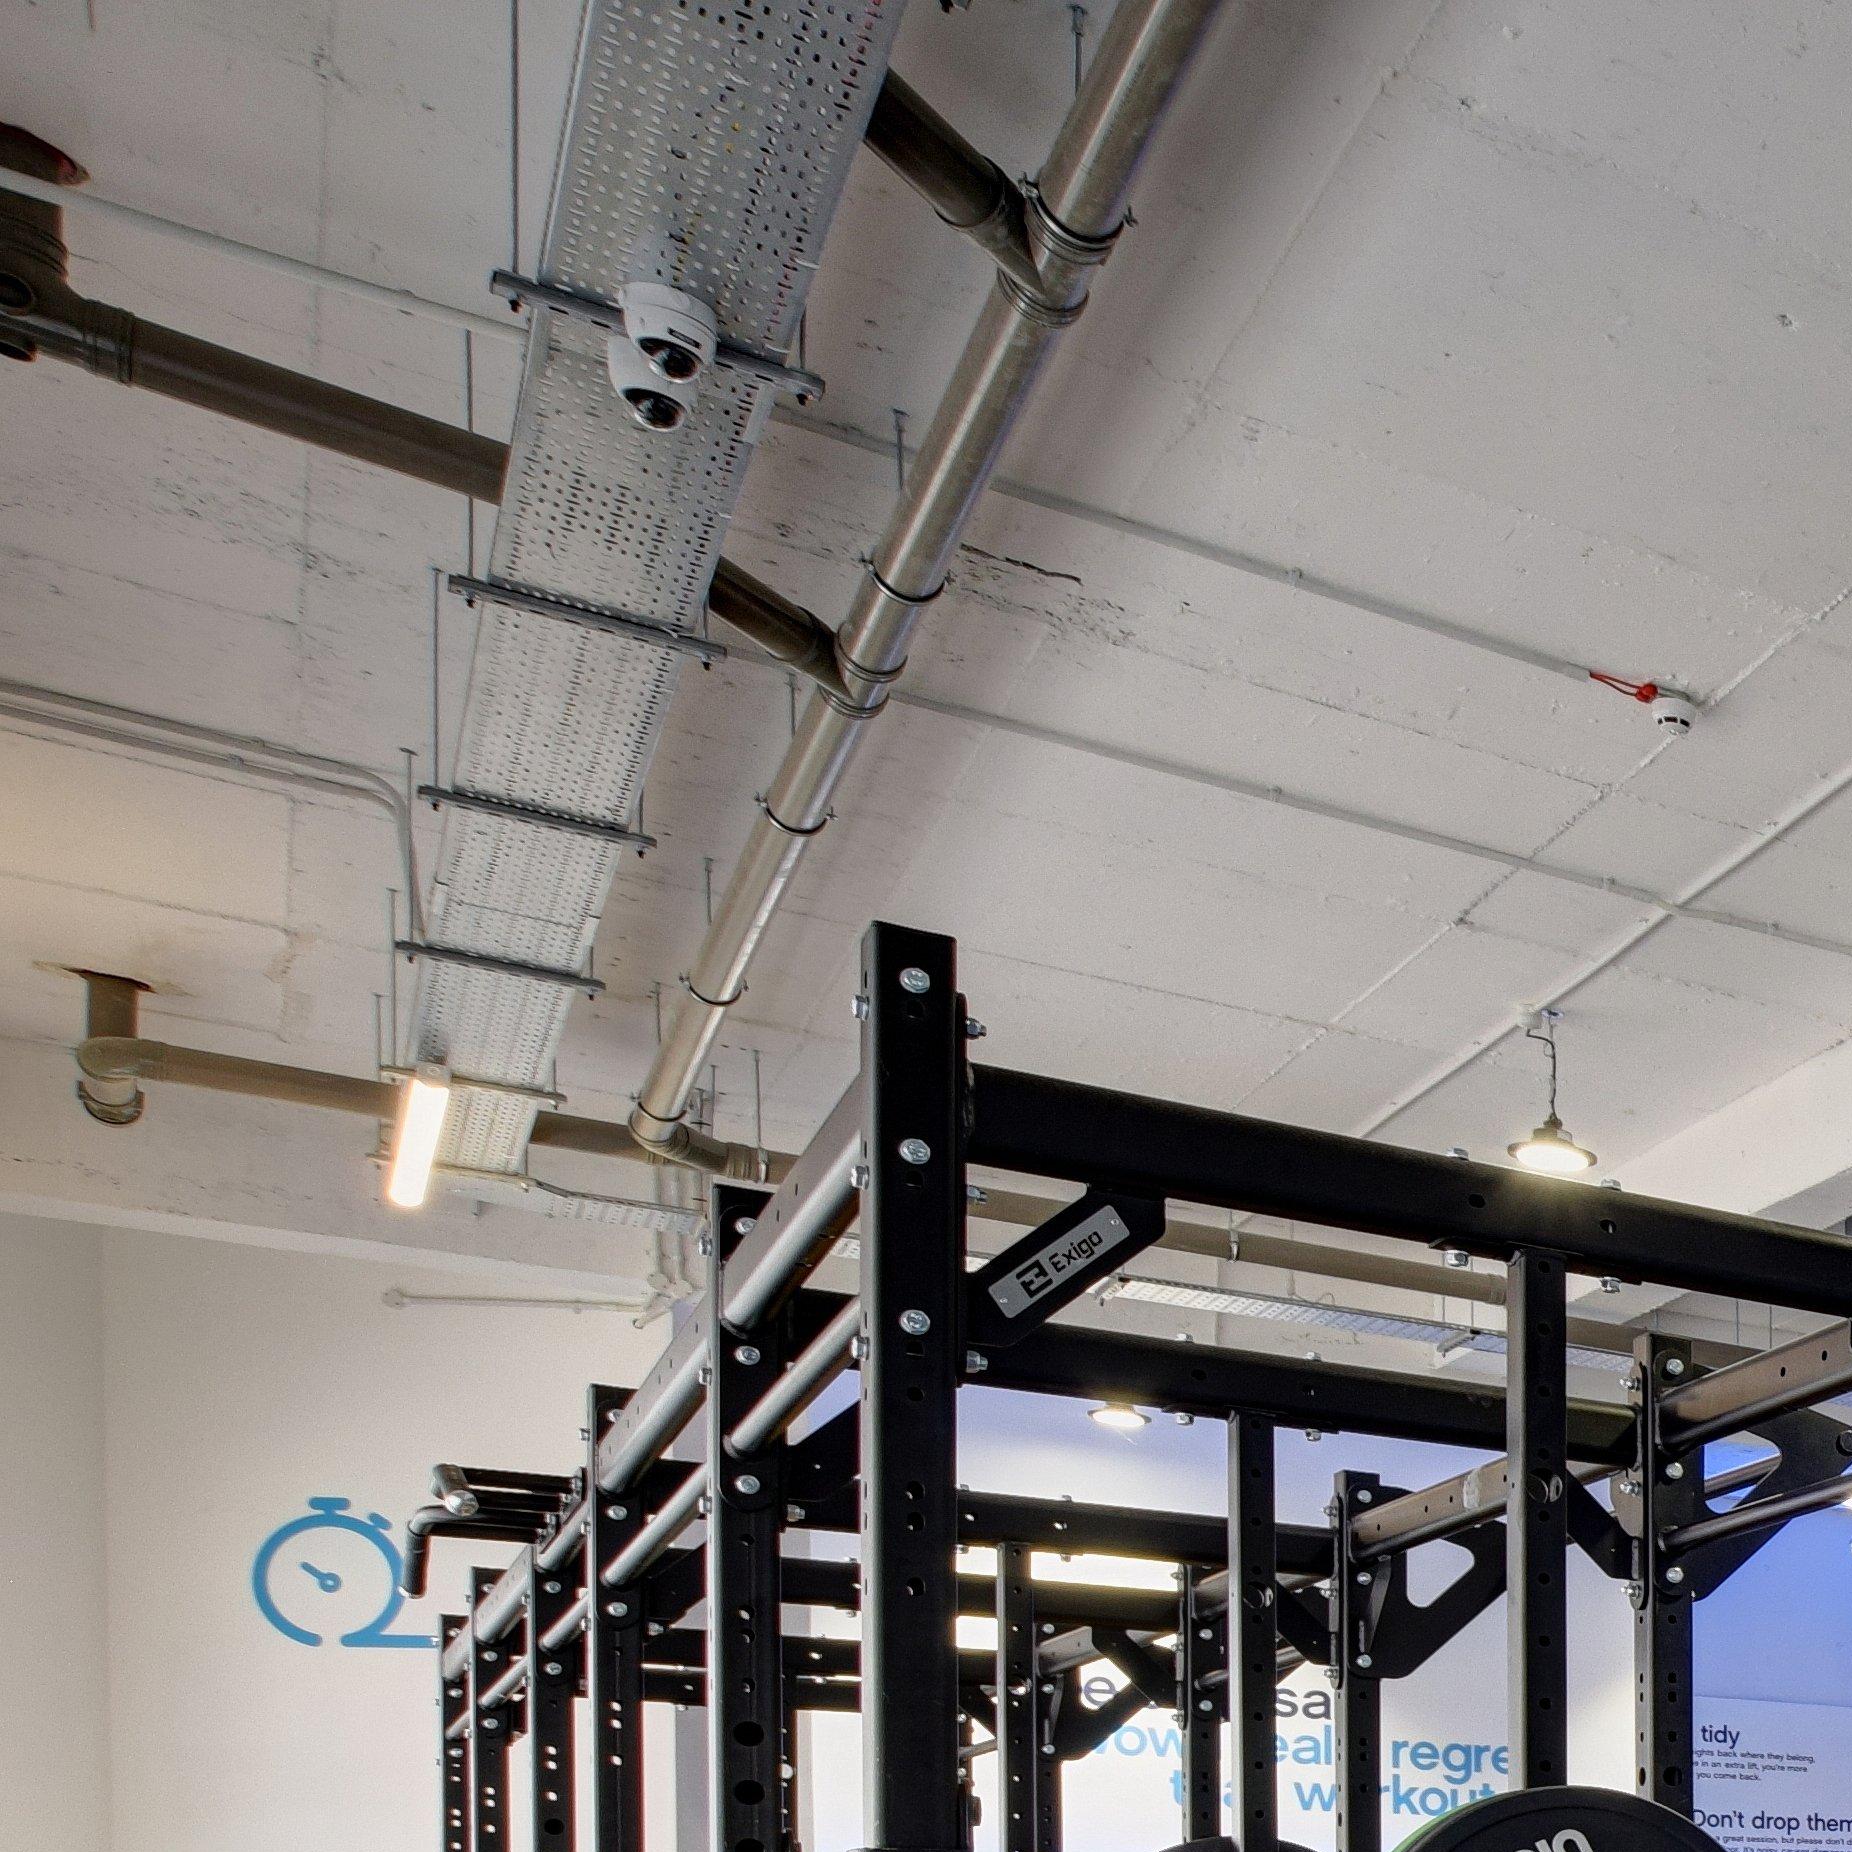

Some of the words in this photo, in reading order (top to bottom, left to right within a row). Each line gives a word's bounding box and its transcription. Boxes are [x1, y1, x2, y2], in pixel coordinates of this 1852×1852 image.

[1049, 1230, 1104, 1273] Exigo
[1701, 1724, 1740, 1749] tidy
[1391, 1740, 1509, 1785] regre
[1717, 1750, 1737, 1758] back
[1767, 1752, 1784, 1762] they
[1692, 1809, 1745, 1828] Don't
[1752, 1810, 1800, 1835] drop
